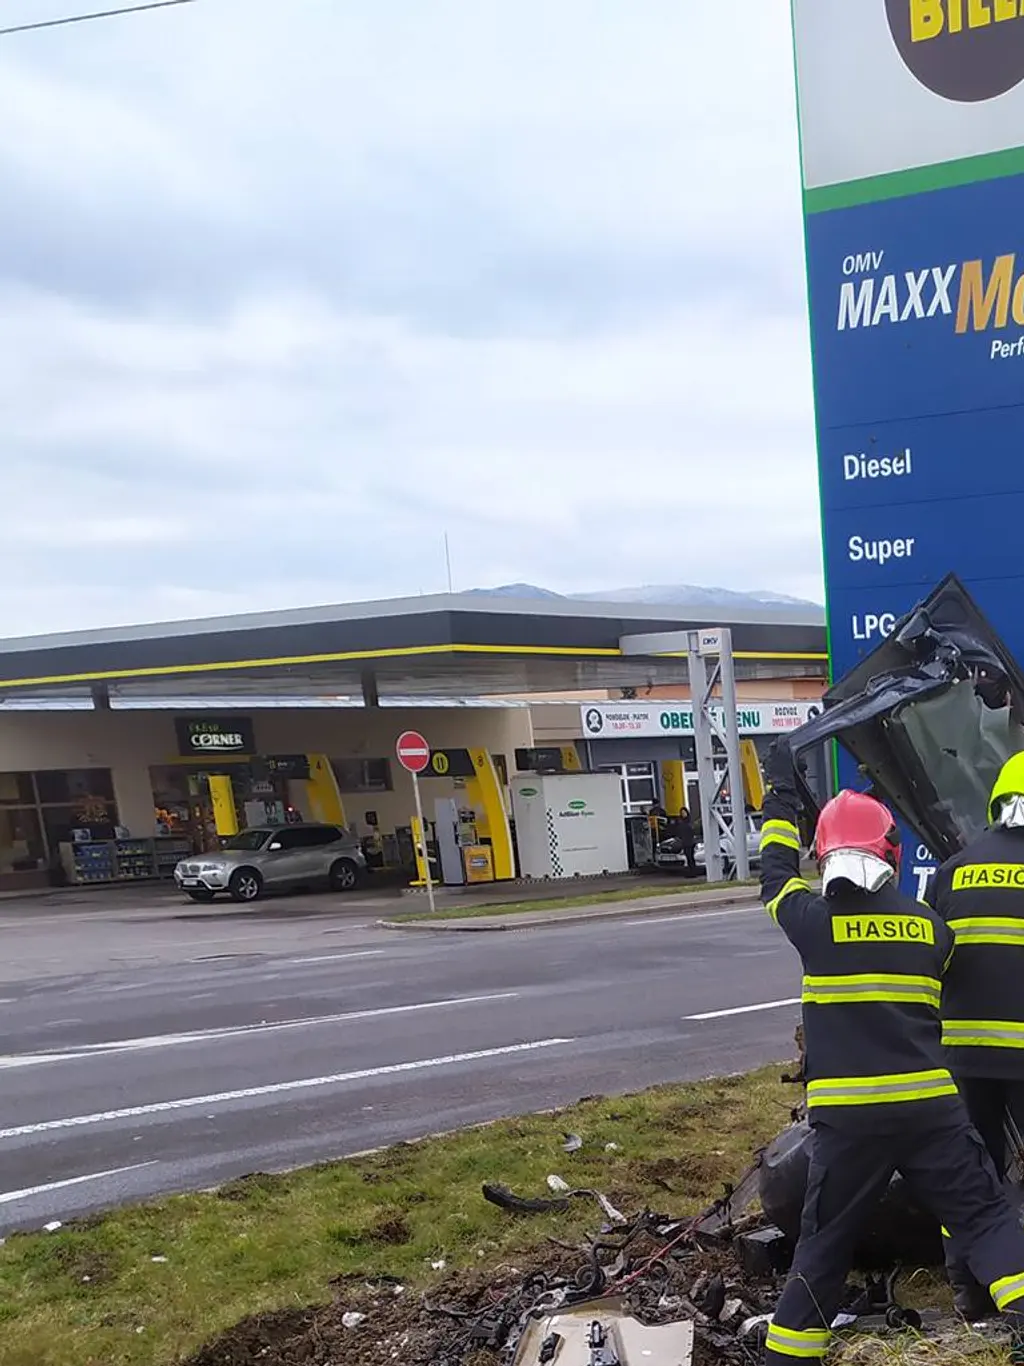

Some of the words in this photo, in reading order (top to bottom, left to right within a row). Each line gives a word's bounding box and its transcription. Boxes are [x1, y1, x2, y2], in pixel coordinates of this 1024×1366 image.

[842, 250, 884, 276] OMV
[843, 450, 912, 480] Diesel
[848, 535, 915, 564] Super
[852, 613, 895, 639] LPG
[191, 733, 243, 746] CORNER
[846, 918, 926, 939] HASIČI
